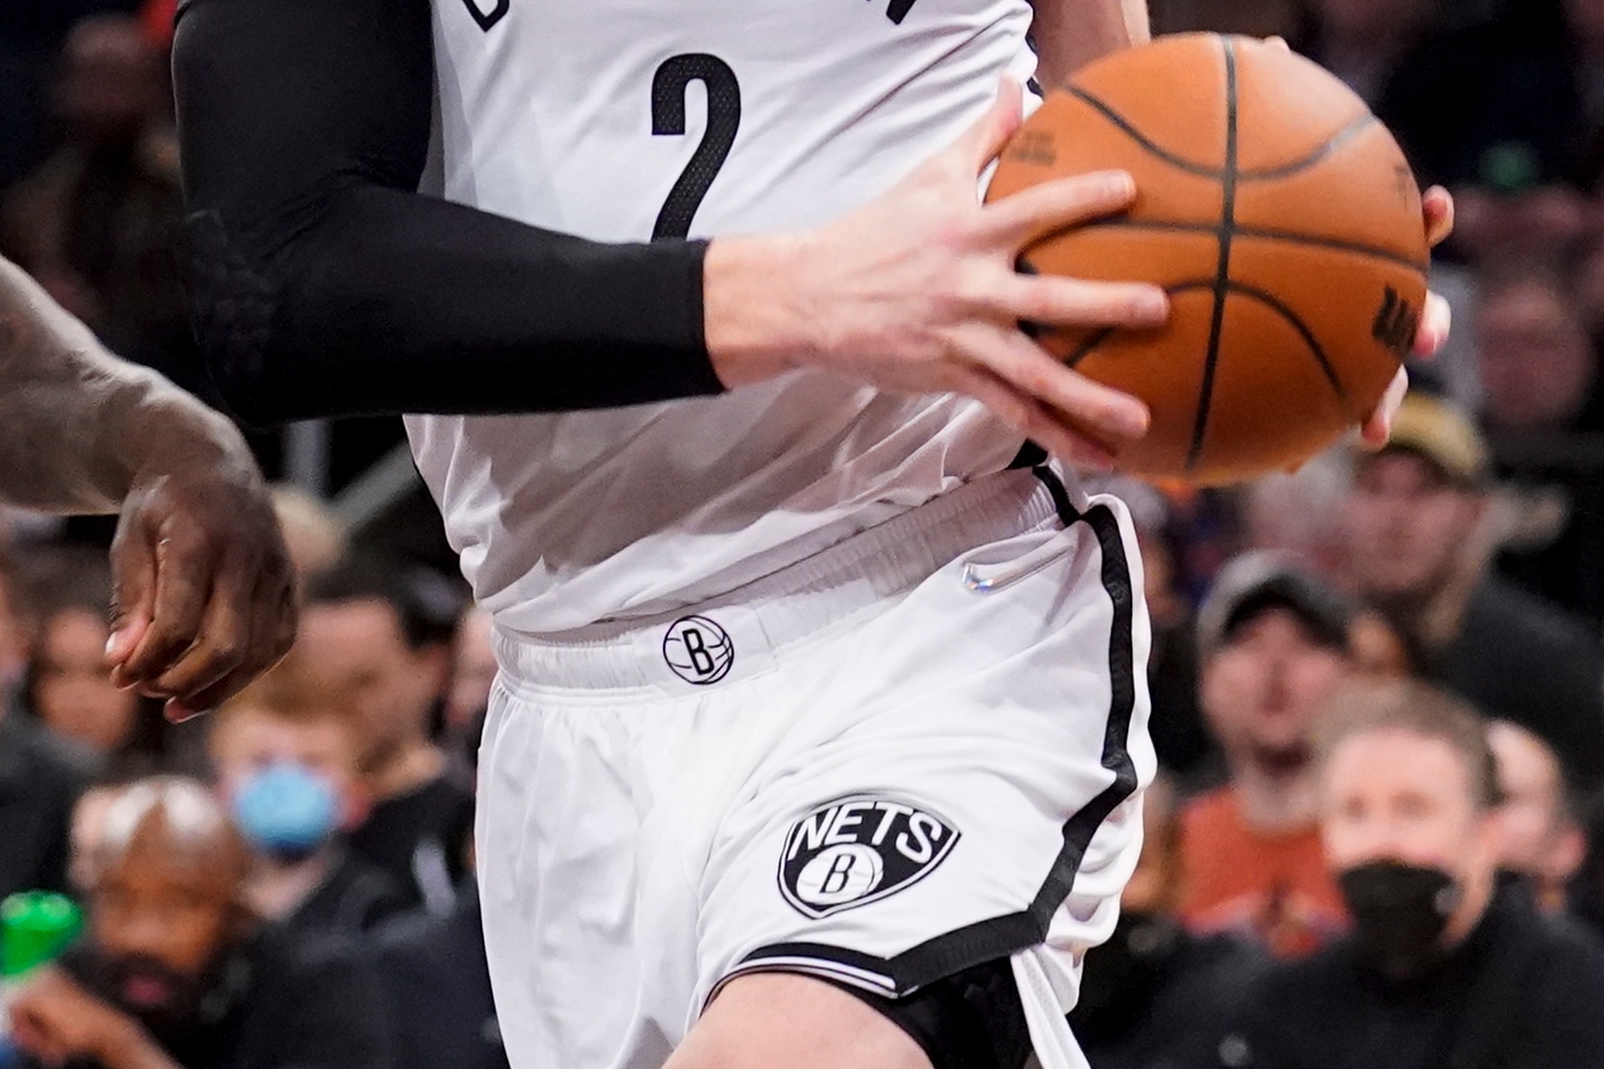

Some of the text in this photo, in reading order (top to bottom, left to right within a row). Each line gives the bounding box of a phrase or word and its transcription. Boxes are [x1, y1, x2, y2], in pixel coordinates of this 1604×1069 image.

[651, 52, 742, 244] 2
[682, 627, 715, 677] B
[787, 801, 943, 864] NETS
[819, 853, 857, 894] B
